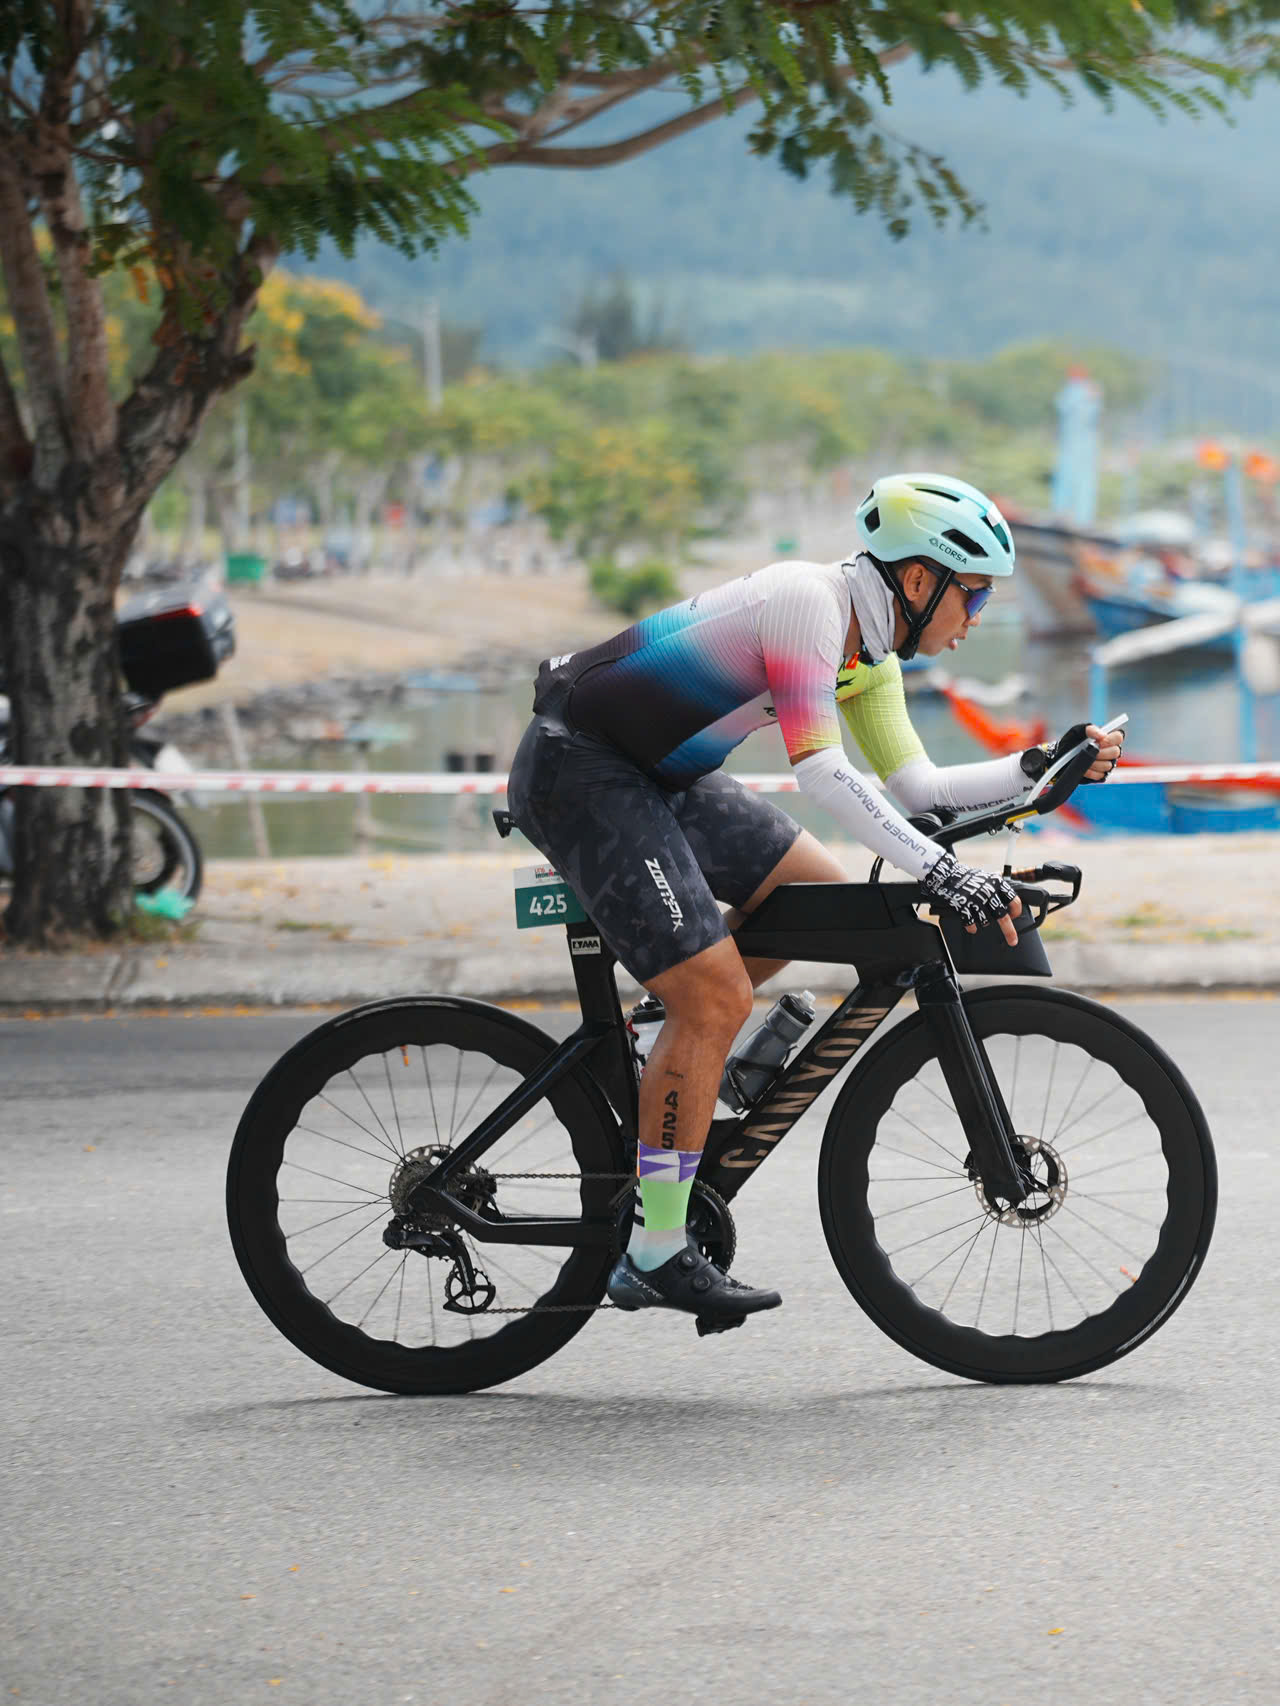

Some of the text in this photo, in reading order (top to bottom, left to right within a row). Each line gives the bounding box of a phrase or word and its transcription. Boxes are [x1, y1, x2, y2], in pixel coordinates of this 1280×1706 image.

[939, 543, 967, 565] CORSA
[833, 768, 927, 857] UNDER ARMOUR
[529, 894, 568, 917] 425
[719, 1007, 891, 1168] CANYON
[661, 1089, 679, 1151] 425
